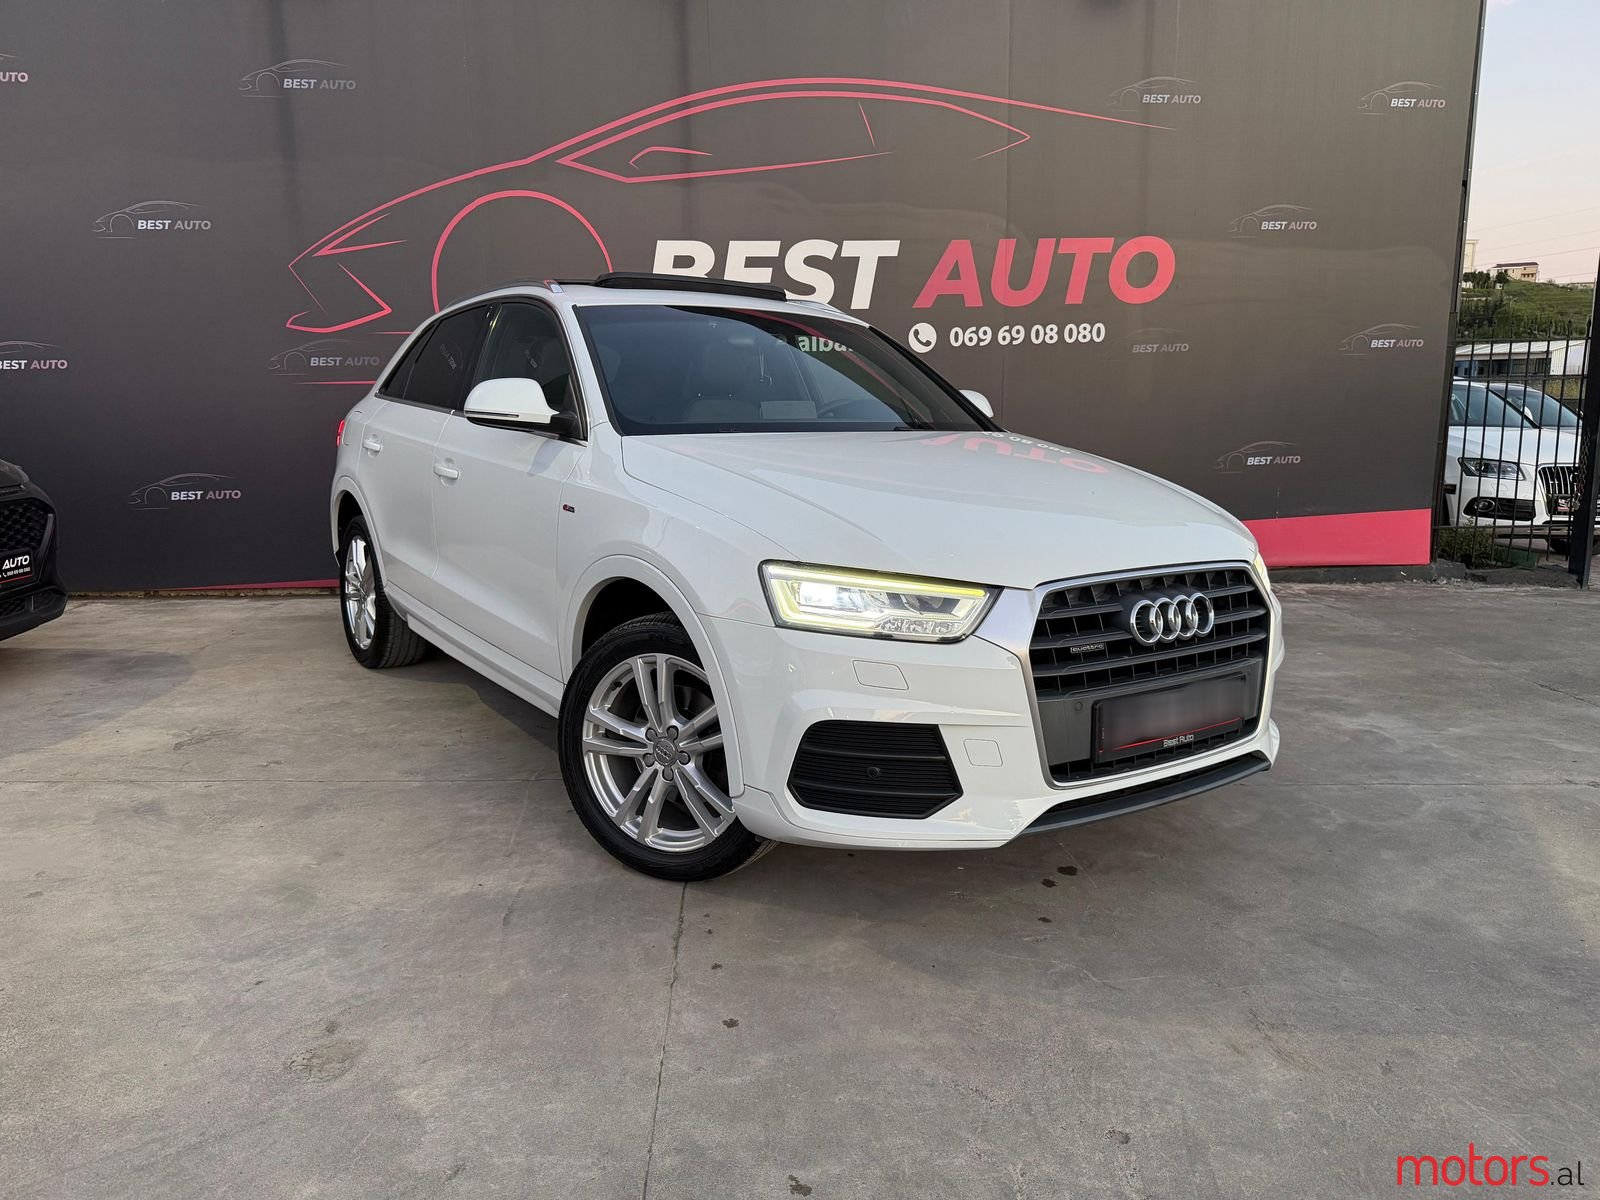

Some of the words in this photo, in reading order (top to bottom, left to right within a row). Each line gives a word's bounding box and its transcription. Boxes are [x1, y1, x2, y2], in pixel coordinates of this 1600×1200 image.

[283, 78, 317, 90] BEST
[319, 79, 356, 91] AUTO
[1142, 94, 1170, 104] BEST
[1171, 94, 1202, 104] AUTO
[1390, 98, 1416, 108] BEST
[1417, 98, 1446, 108] AUTO
[137, 219, 172, 230] BEST
[174, 219, 212, 230] AUTO
[1260, 221, 1287, 230] BEST
[1288, 221, 1317, 230] AUTO
[653, 239, 900, 310] BEST
[913, 236, 1176, 308] AUTO
[949, 324, 993, 347] 069
[997, 324, 1026, 346] 69
[1030, 323, 1059, 345] 08
[1063, 322, 1106, 343] 080
[1132, 343, 1159, 353] BEST
[1160, 343, 1190, 353] AUTO
[1370, 339, 1396, 348] BEST
[1396, 339, 1424, 348] AUTO
[0, 359, 28, 370] EST
[30, 359, 68, 370] AUTO
[309, 356, 343, 367] BEST
[344, 355, 380, 367] AUTO
[1246, 455, 1272, 466] BEST
[1273, 455, 1301, 465] AUTO
[170, 489, 203, 500] BEST
[205, 488, 242, 500] AUTO
[2, 555, 30, 570] AUTO
